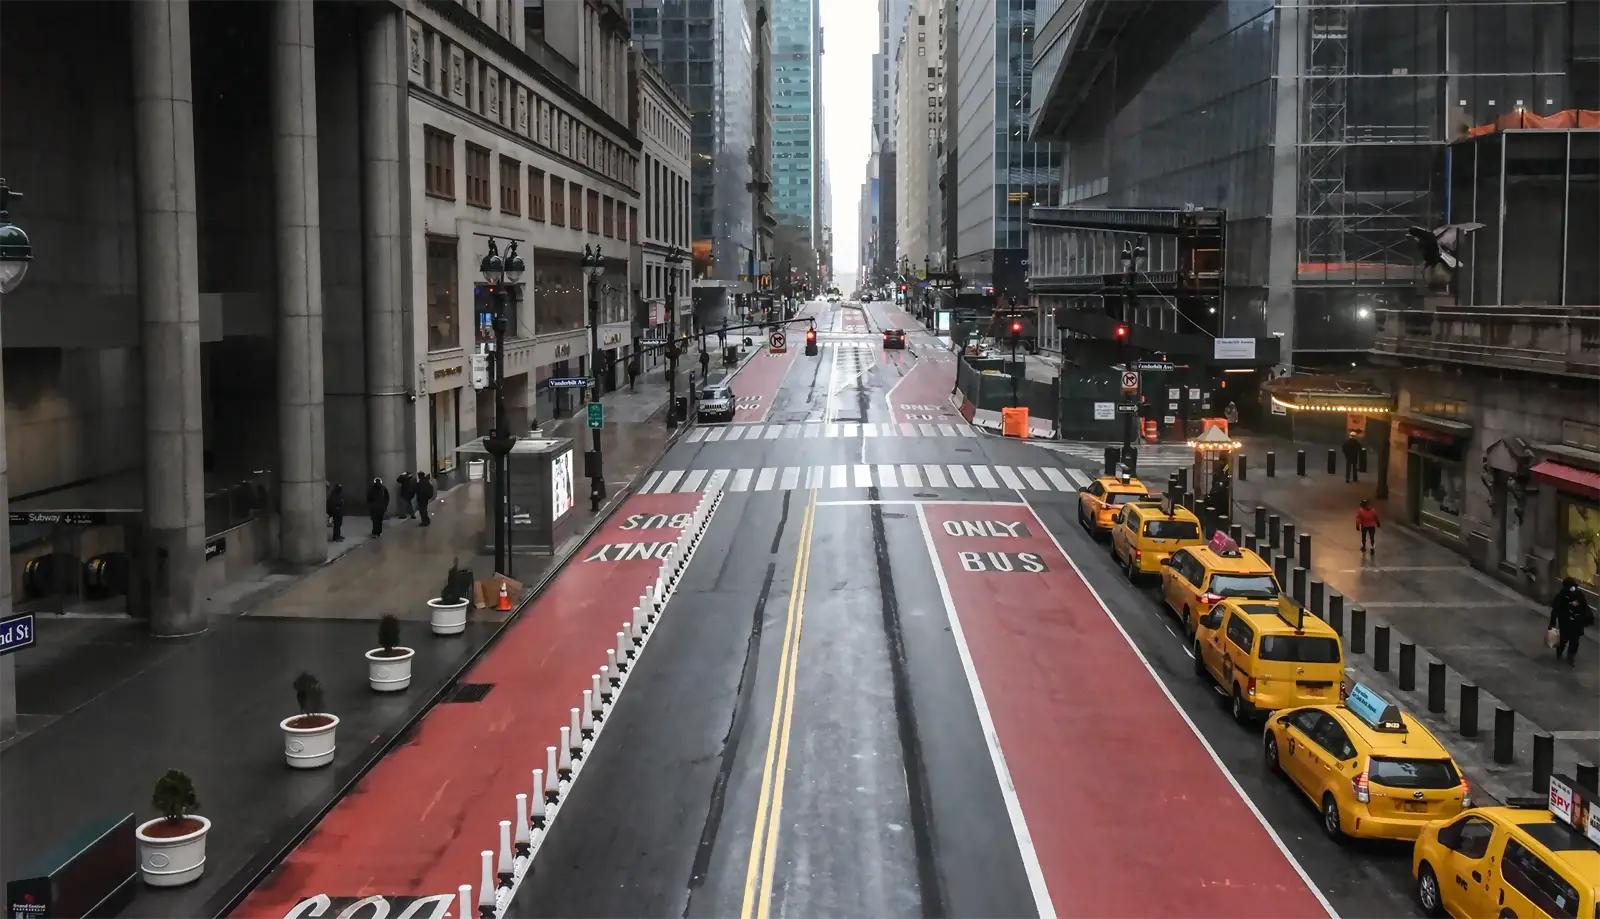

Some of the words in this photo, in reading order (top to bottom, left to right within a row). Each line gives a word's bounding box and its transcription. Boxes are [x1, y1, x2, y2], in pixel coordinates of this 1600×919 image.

[29, 514, 60, 522] Subway
[619, 513, 692, 530] BUS
[942, 520, 1020, 538] ONLY
[582, 542, 678, 562] ONLY
[958, 552, 1044, 572] BUS
[16, 624, 29, 640] St
[1551, 786, 1558, 794] MY
[1550, 792, 1570, 812] SPY
